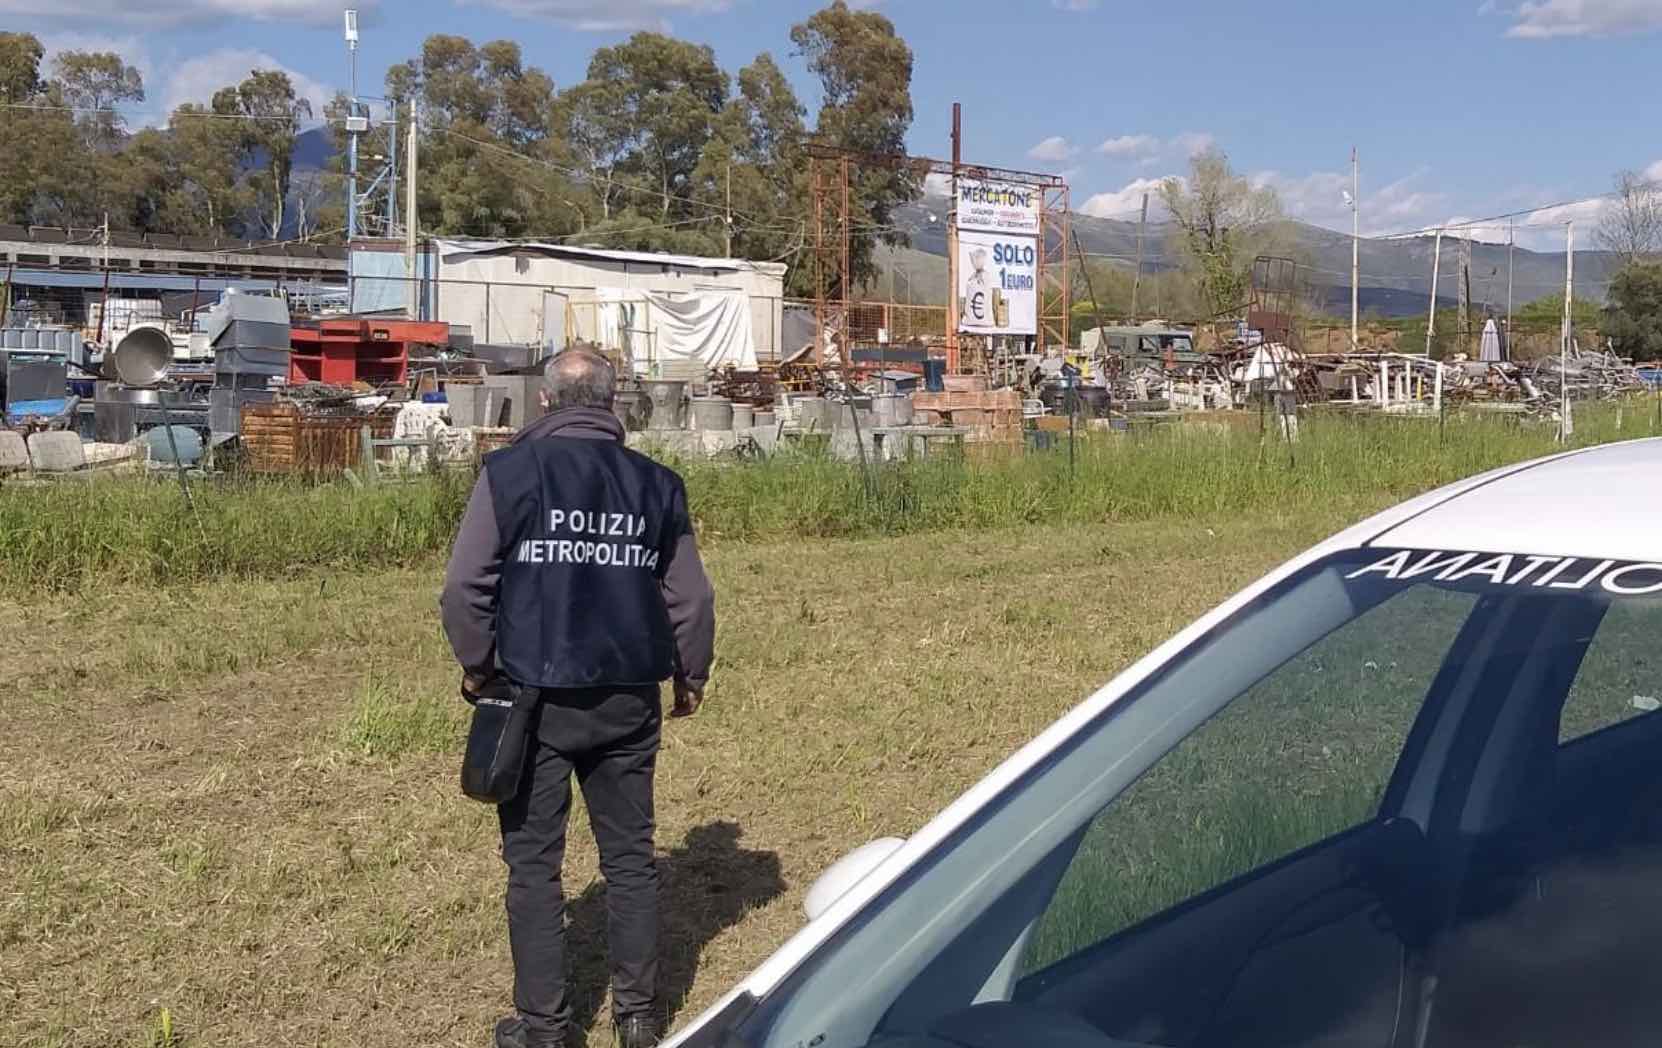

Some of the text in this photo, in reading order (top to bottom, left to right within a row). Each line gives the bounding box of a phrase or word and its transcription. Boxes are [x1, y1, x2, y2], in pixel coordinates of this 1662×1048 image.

[961, 186, 1033, 208] MERCATONE
[992, 243, 1034, 265] SOLO
[1007, 274, 1033, 290] EURO
[550, 508, 646, 537] POLIZIA
